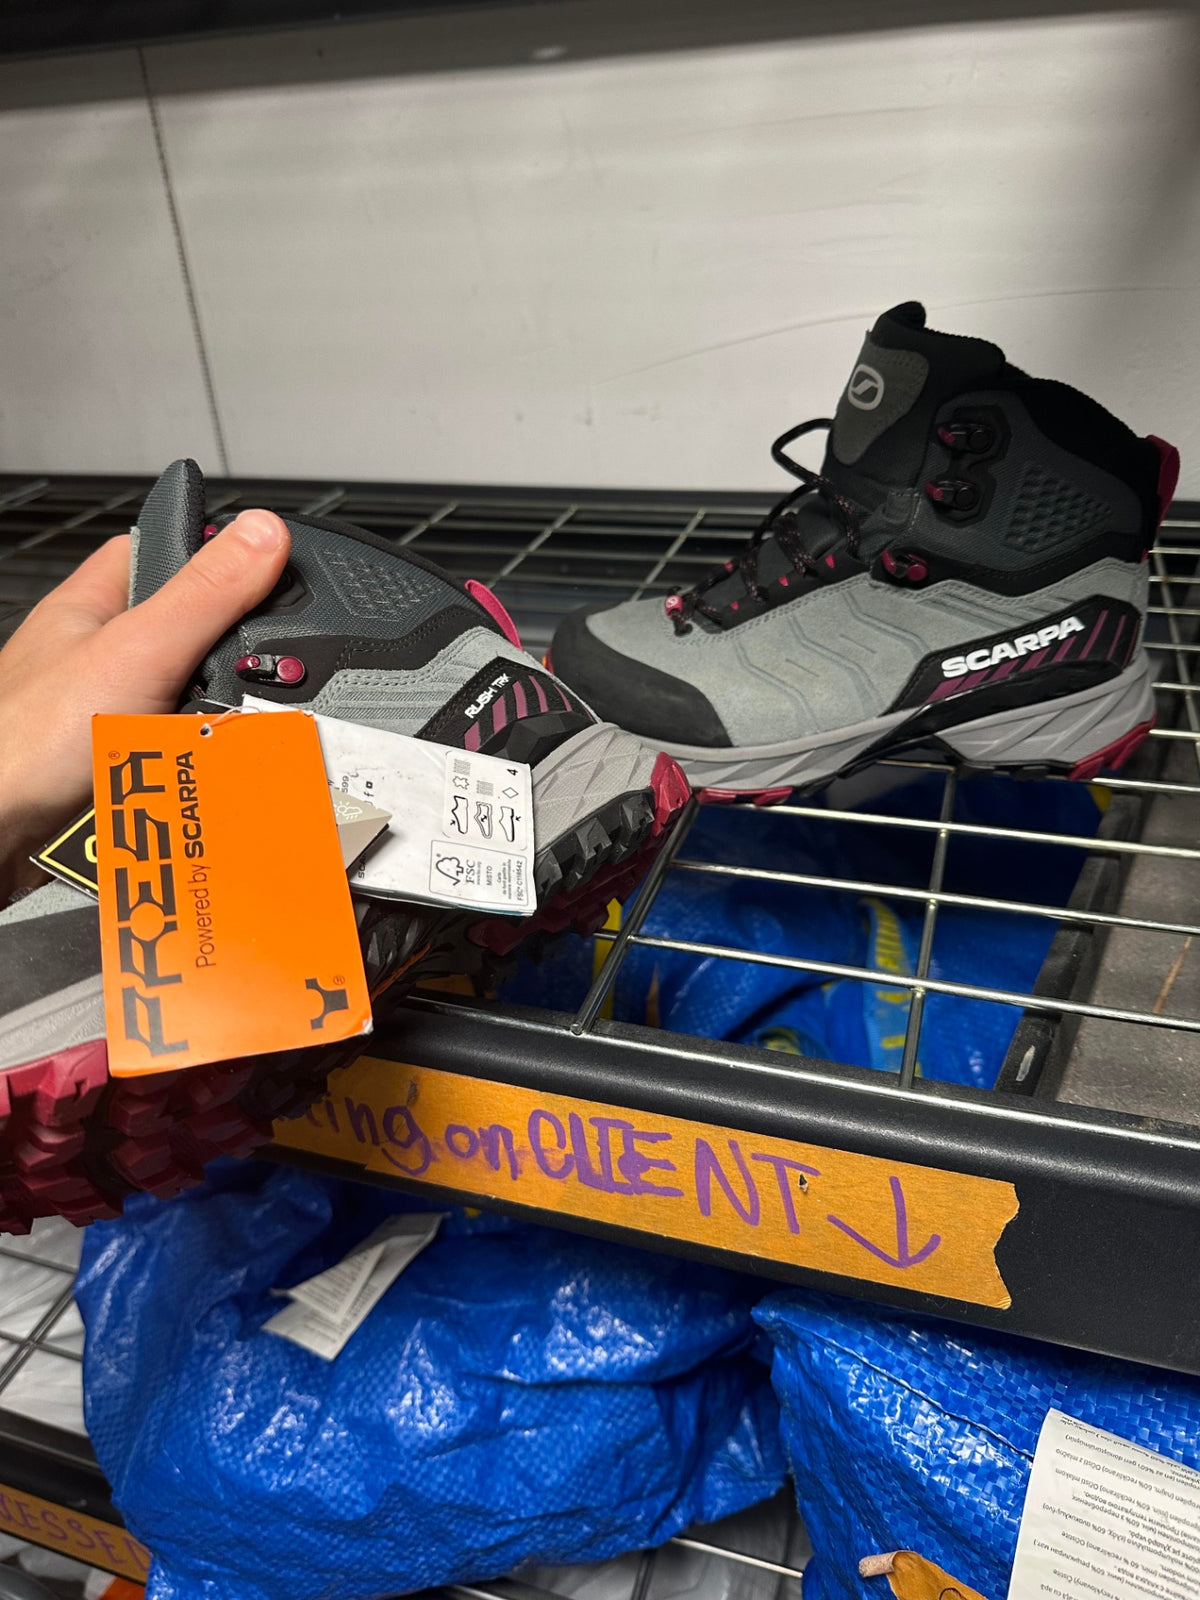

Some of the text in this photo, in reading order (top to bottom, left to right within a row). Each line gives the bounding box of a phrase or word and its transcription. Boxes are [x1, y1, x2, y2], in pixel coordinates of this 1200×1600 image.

[941, 616, 1086, 678] SCARPA
[464, 687, 498, 719] RUSH
[176, 751, 217, 968] Powered by SCARPA
[465, 860, 475, 884] FSC
[447, 1121, 518, 1180] on
